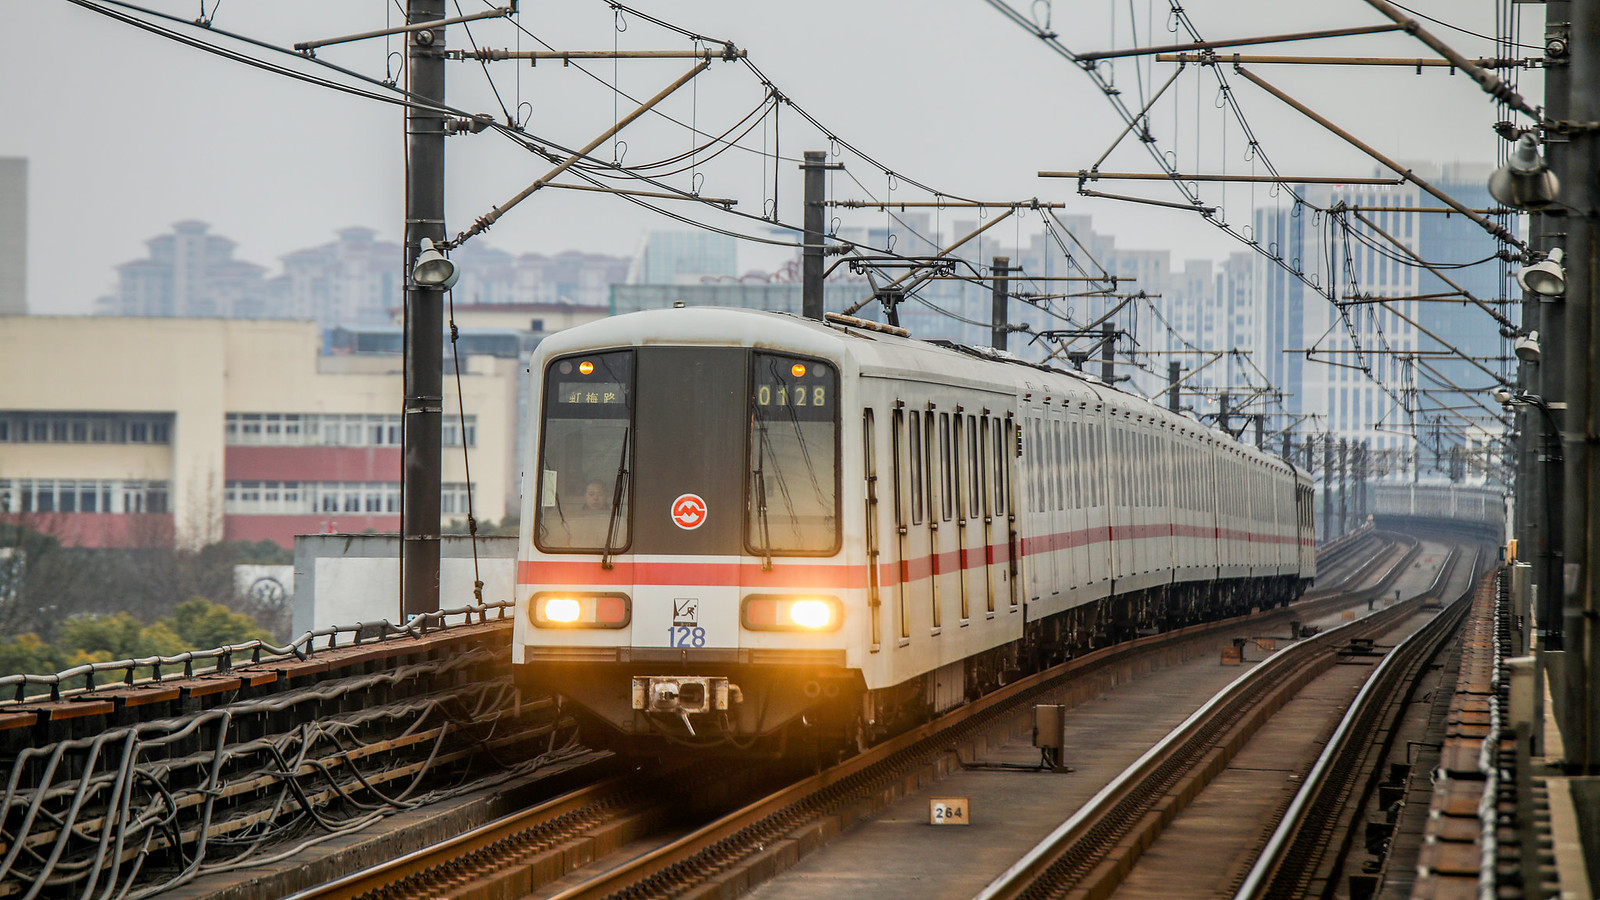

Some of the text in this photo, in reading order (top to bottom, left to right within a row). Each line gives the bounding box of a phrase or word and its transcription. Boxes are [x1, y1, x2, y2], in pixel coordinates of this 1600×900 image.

[758, 386, 825, 406] 0128
[668, 627, 705, 648] 128
[935, 806, 962, 819] 264
